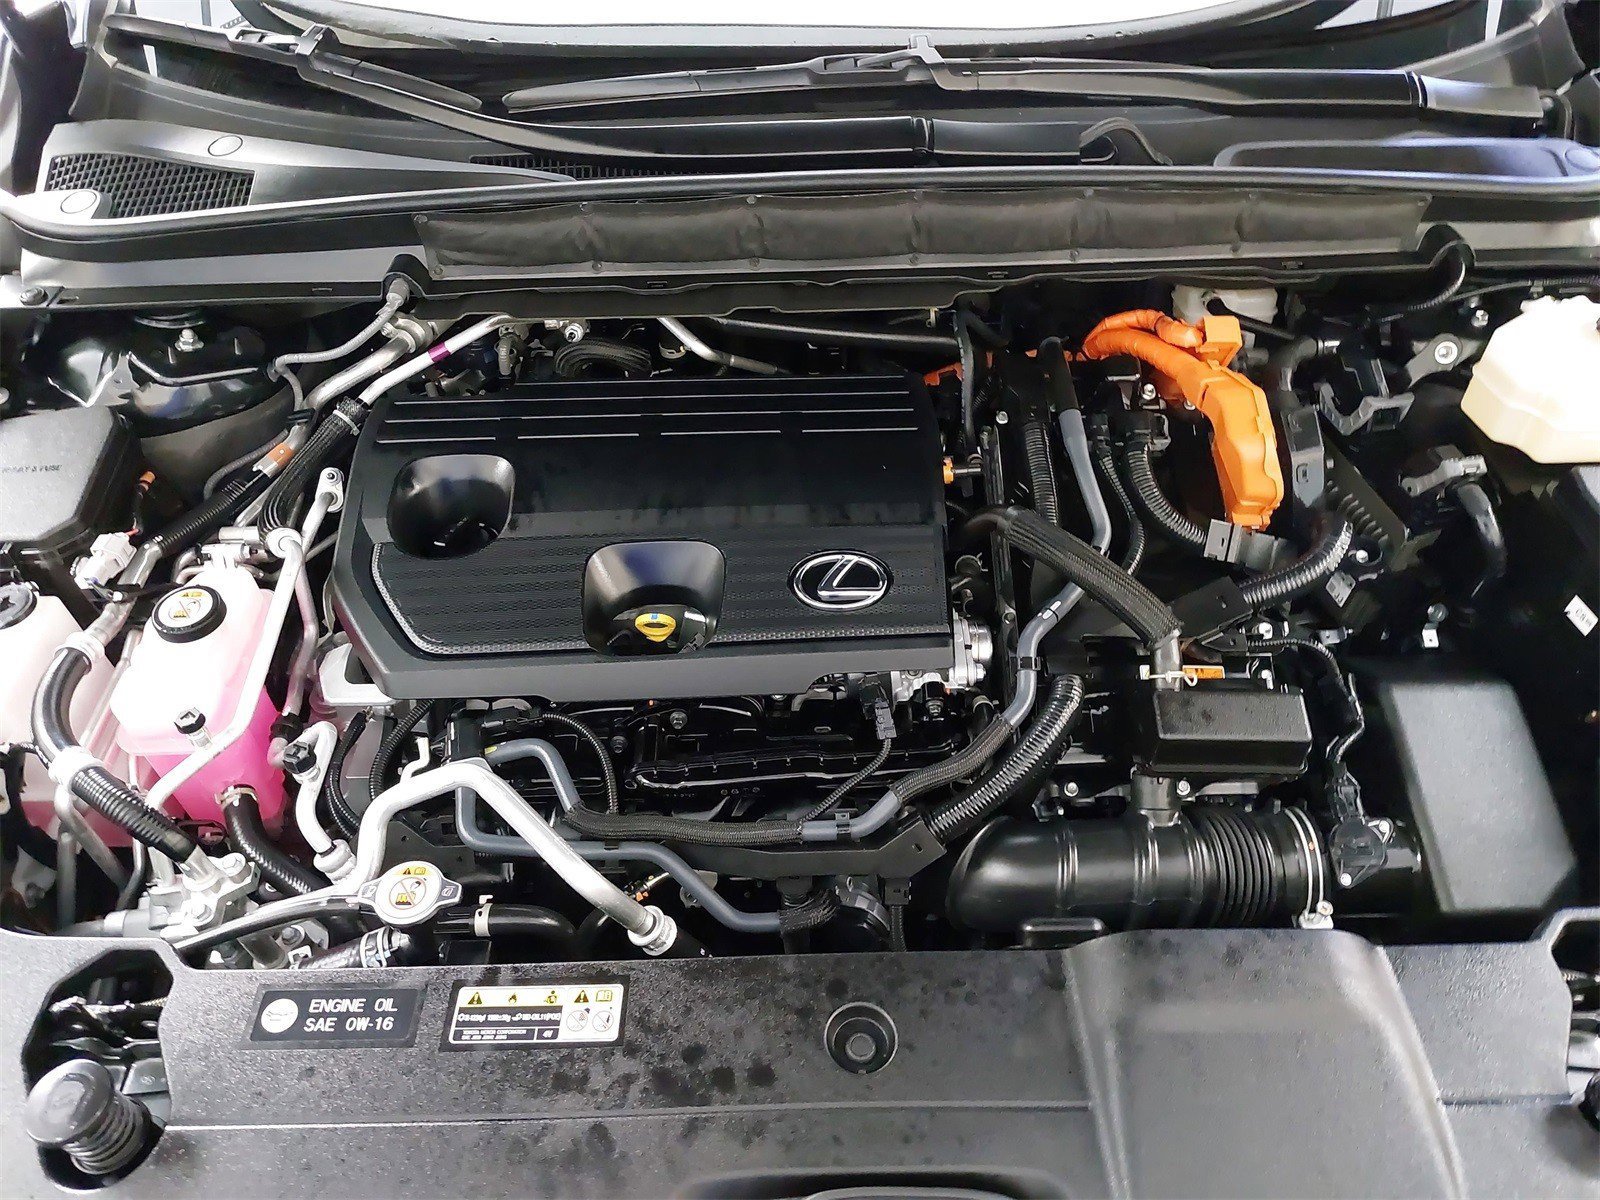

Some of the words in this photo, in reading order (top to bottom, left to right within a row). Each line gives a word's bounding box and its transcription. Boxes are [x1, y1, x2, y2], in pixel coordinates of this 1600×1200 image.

[308, 998, 367, 1013] ENGINE
[374, 997, 398, 1012] OIL
[303, 1017, 338, 1032] SAE
[345, 1016, 395, 1031] 0W-16
